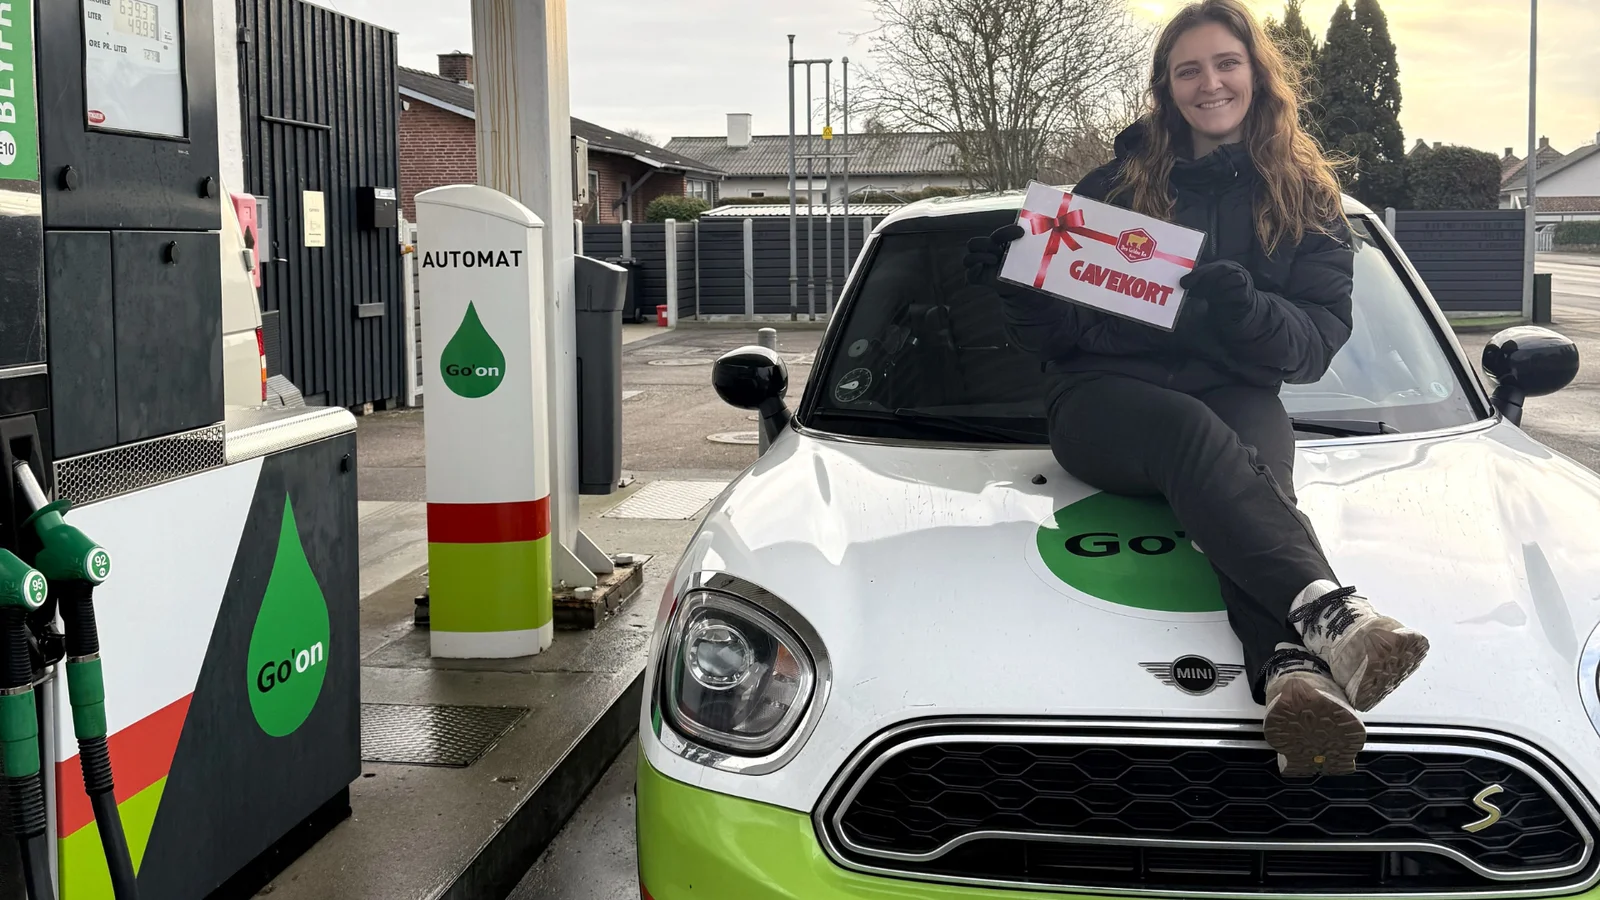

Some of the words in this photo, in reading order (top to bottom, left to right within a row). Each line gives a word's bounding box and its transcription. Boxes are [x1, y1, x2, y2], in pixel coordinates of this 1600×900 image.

[88, 11, 102, 21] LITER
[89, 39, 101, 48] ØRE
[113, 44, 128, 54] LITER
[422, 250, 523, 268] AUTOMAT
[1069, 260, 1174, 306] GAVEKORT
[446, 364, 499, 377] Go'on
[1064, 530, 1204, 558] Go'
[94, 554, 107, 567] 92
[32, 578, 43, 591] 95
[257, 640, 323, 693] Go'on
[1176, 667, 1213, 680] MINI
[1461, 784, 1504, 833] S
